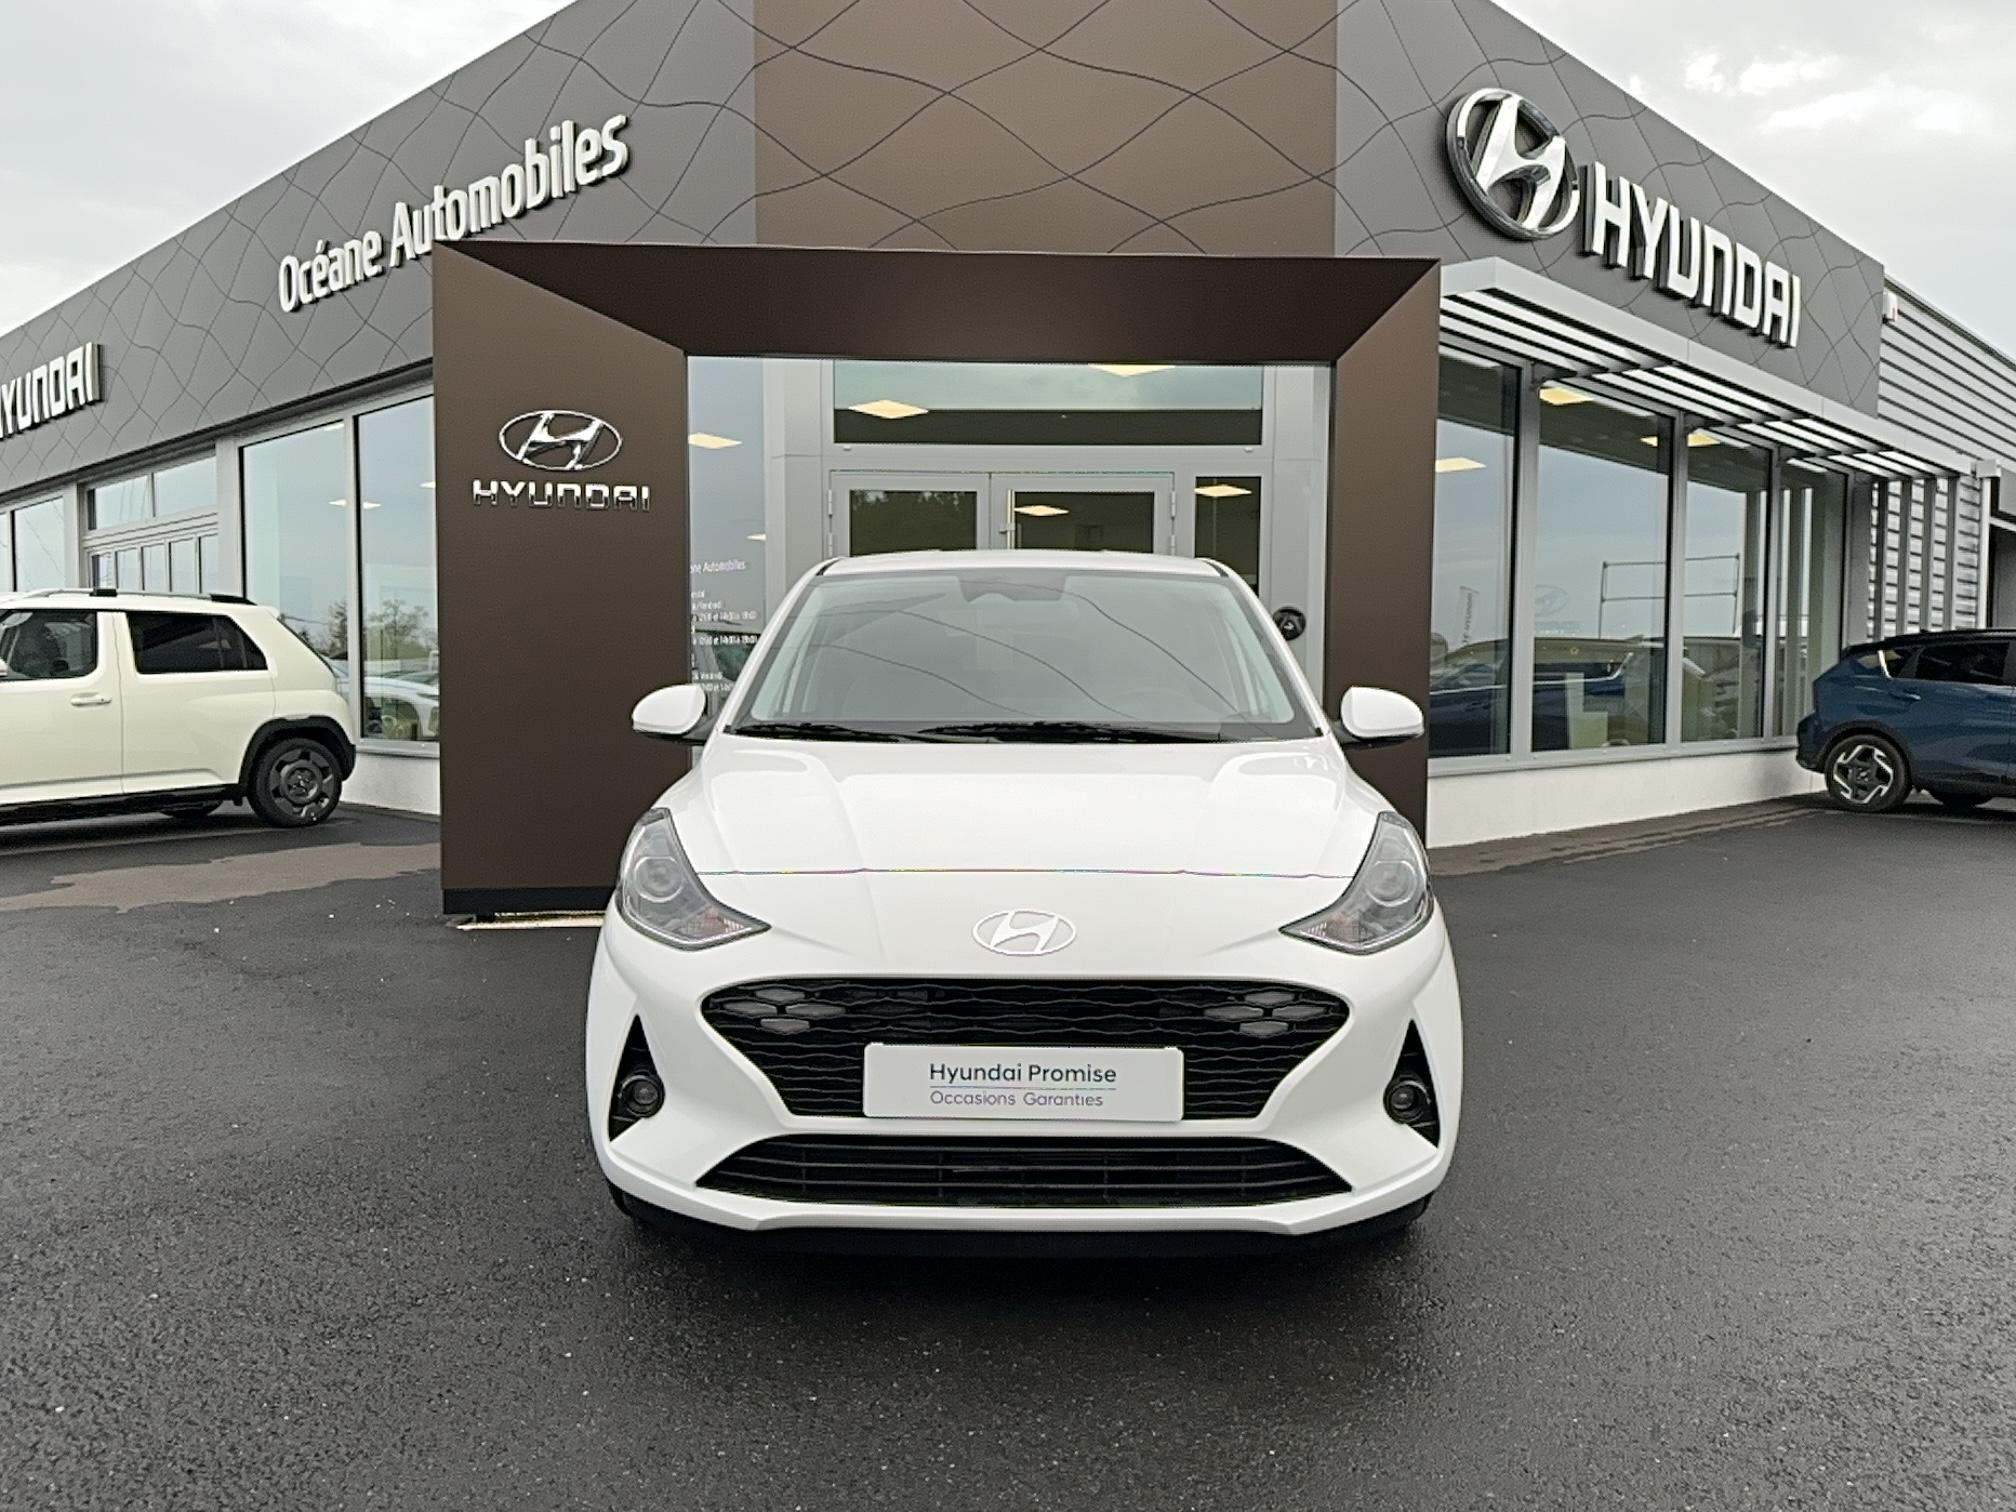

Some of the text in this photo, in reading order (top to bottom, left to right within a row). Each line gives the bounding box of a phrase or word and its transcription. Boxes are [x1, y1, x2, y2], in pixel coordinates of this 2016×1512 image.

[279, 114, 628, 312] Océane Automobiles
[1588, 160, 1801, 347] HYUNDAI
[472, 479, 651, 511] HYUNDAI
[929, 1063, 1117, 1084] Hyundai Promise
[930, 1090, 1104, 1107] Occasions Garanties
